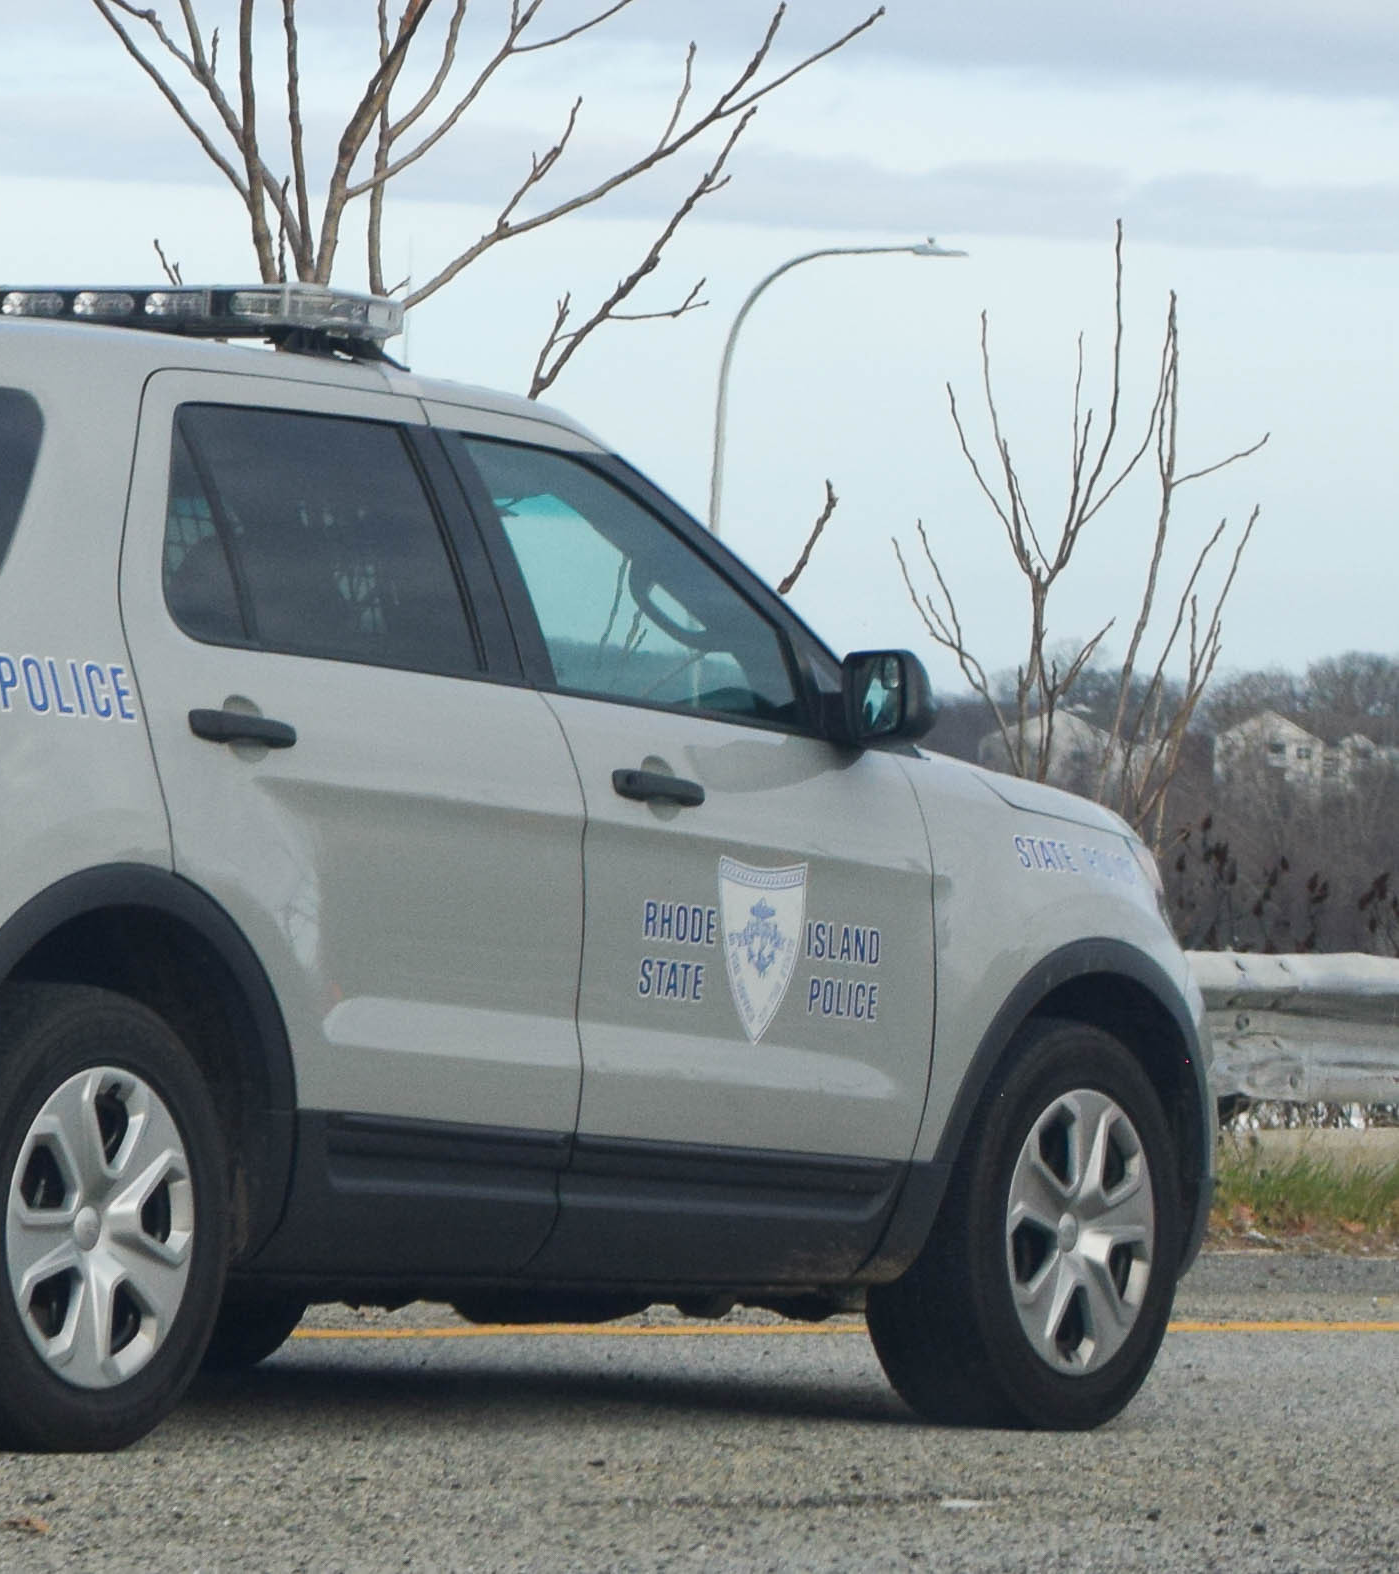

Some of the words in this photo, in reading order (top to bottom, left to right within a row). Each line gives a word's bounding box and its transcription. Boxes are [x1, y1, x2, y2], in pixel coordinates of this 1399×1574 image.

[1013, 834, 1081, 873] STATE
[642, 899, 718, 947] RHODE
[805, 919, 882, 967] ISLAND
[638, 957, 706, 1003] STATE
[807, 976, 880, 1023] POLICE
